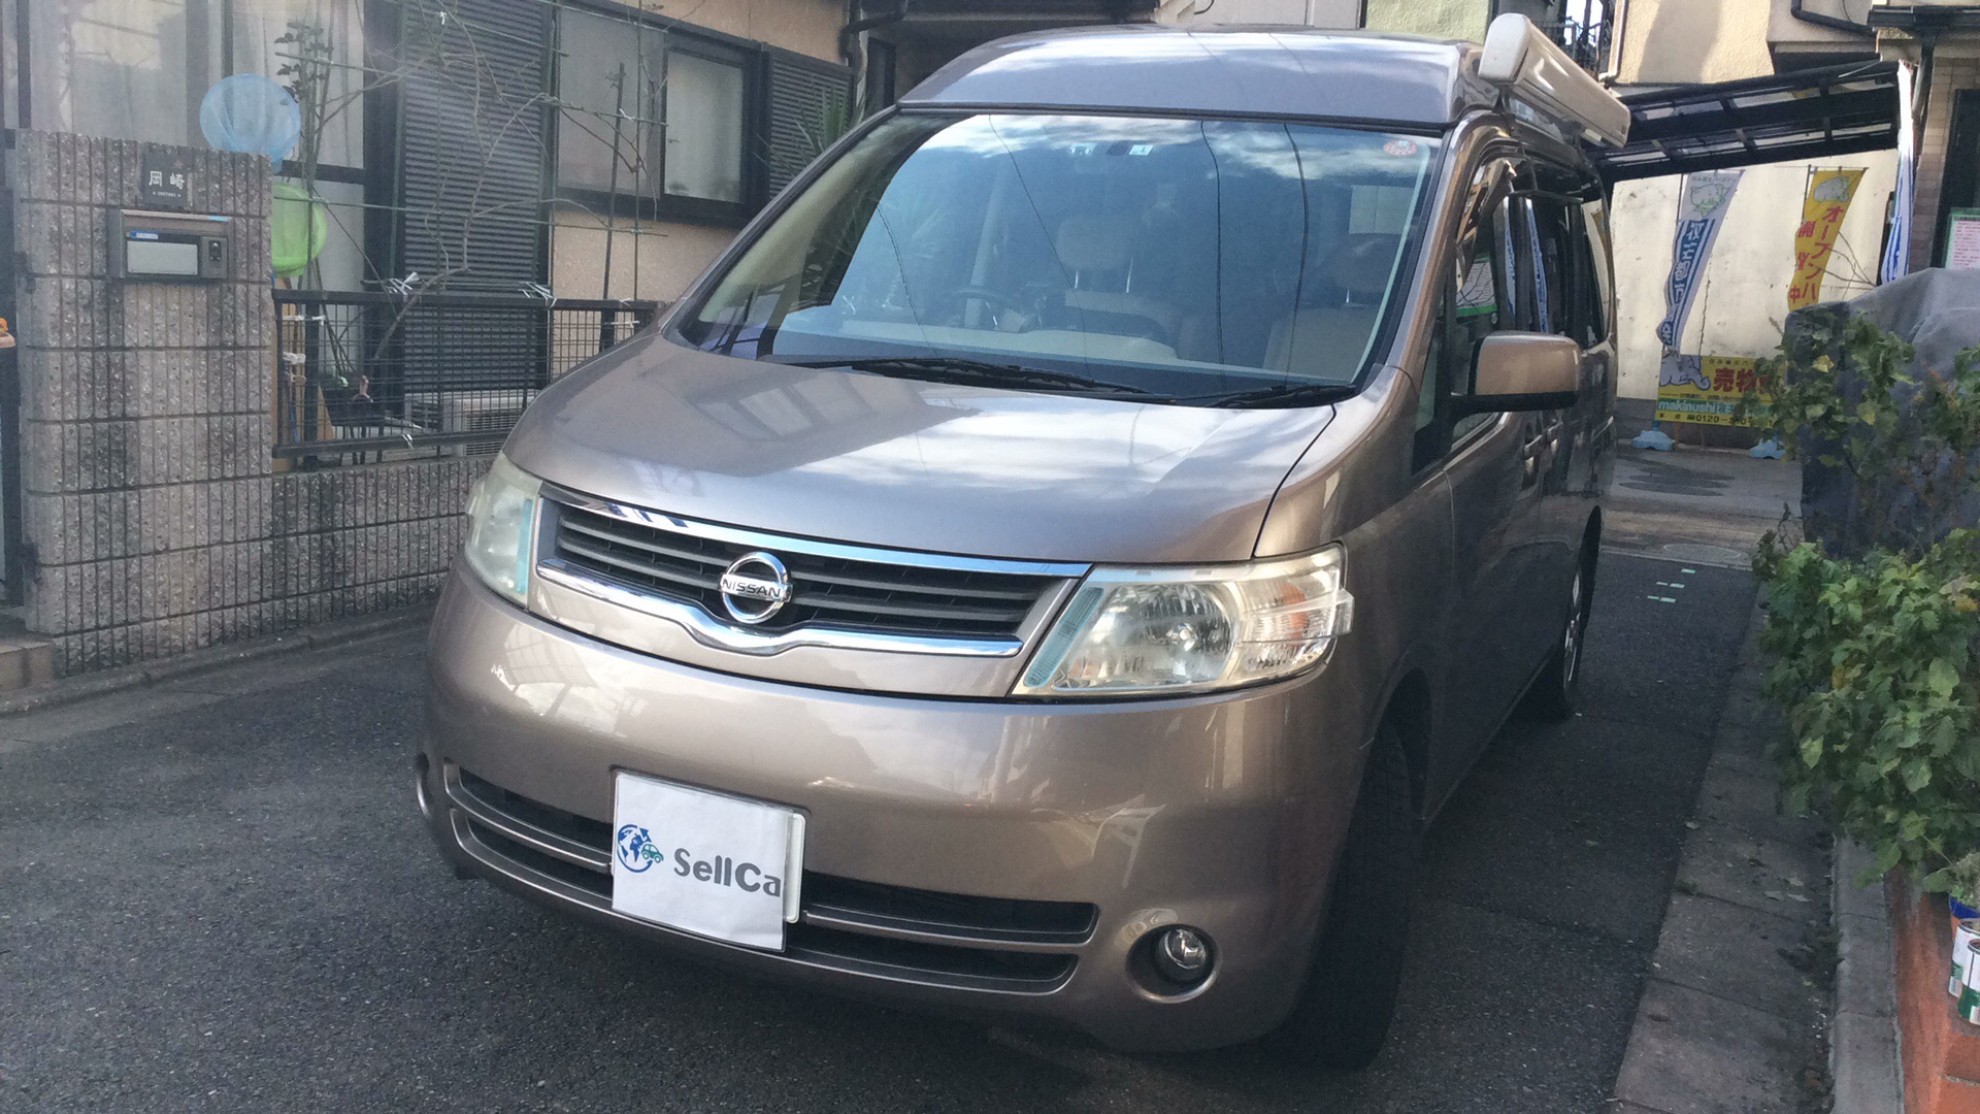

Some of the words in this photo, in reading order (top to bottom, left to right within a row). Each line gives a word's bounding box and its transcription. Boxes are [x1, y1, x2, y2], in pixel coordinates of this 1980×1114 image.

[1802, 205, 1844, 303] オープンハ
[722, 578, 782, 598] NISSAN
[673, 847, 782, 898] SellCa
